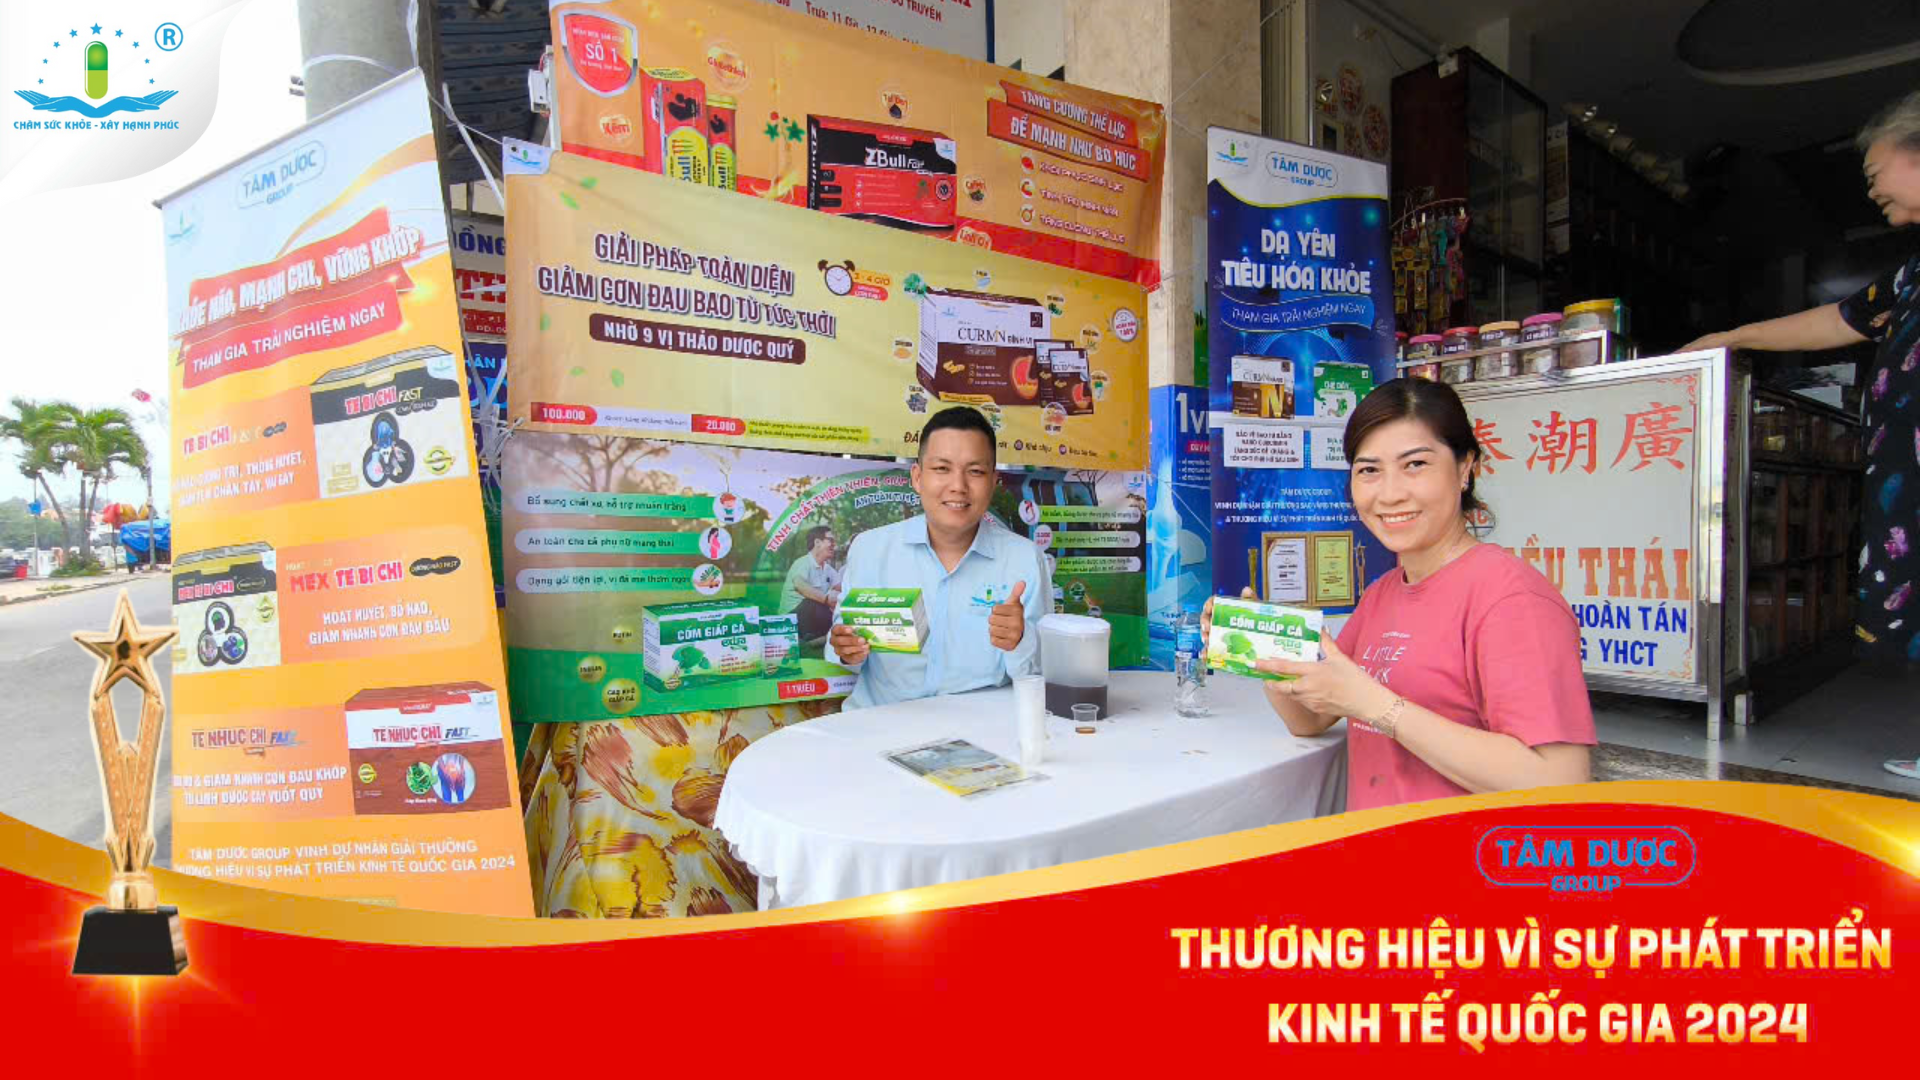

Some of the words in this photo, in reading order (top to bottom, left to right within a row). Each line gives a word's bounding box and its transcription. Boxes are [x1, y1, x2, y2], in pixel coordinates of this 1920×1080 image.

[585, 41, 605, 61] SỐ
[611, 47, 618, 63] 1
[1011, 114, 1029, 138] ĐỂ
[1031, 123, 1067, 150] MẠNH
[1069, 137, 1095, 159] NHƯ
[1271, 155, 1299, 173] TÂM
[1302, 163, 1333, 181] DƯỢC
[242, 169, 277, 199] TÂM
[453, 224, 506, 256] ỒNG
[1261, 229, 1290, 260] DẠ
[1297, 227, 1336, 257] YÊN
[239, 270, 286, 311] MẠNH
[323, 243, 370, 283] VỮNG
[594, 231, 638, 264] GIẢI
[643, 241, 694, 273] PHÁP
[698, 255, 747, 287] TOÀN
[750, 264, 794, 297] DIỆN
[1221, 256, 1266, 288] TIÊU
[1271, 261, 1315, 290] HÓA
[1321, 262, 1372, 294] KHỎE
[538, 264, 595, 300] GIẢM
[600, 277, 643, 307] CƠN
[647, 284, 689, 314] ĐAU
[694, 289, 733, 319] BAO
[797, 310, 836, 338] THỜI
[1261, 309, 1280, 323] GIA
[1340, 302, 1365, 316] NGAY
[224, 343, 248, 361] GIA
[284, 315, 346, 344] NGHIỆM
[350, 301, 386, 328] NGAY
[604, 321, 638, 341] NHỜ
[643, 327, 652, 343] 9
[657, 329, 673, 349] VỊ
[677, 330, 718, 351] THẢO
[722, 336, 762, 358] DƯỢC
[767, 340, 794, 360] QUÝ
[398, 386, 423, 402] FAST
[528, 537, 541, 545] An
[289, 572, 331, 594] MEX
[335, 566, 355, 588] TE
[358, 566, 375, 586] BI
[377, 560, 404, 583] CHI
[1504, 534, 1565, 592] ỀU
[1577, 536, 1691, 600] THÁI
[677, 628, 701, 641] CỐM
[704, 625, 728, 638] GIÁP
[731, 622, 745, 634] CÁ
[1230, 616, 1255, 630] CỐM
[1257, 618, 1285, 634] GIÁP
[1287, 622, 1303, 637] CÁ
[1638, 602, 1687, 633] TÁN
[721, 636, 747, 647] extra
[1599, 638, 1658, 667] YHCT
[420, 725, 442, 741] CHI
[445, 726, 470, 740] FAST
[251, 846, 290, 860] GROUP
[294, 845, 328, 858] VINH
[316, 858, 356, 874] TRIỂN
[359, 859, 388, 873] KINH
[391, 855, 406, 873] TẾ
[409, 855, 447, 873] QUỐC
[451, 858, 477, 872] GIA
[480, 854, 516, 870] 2024
